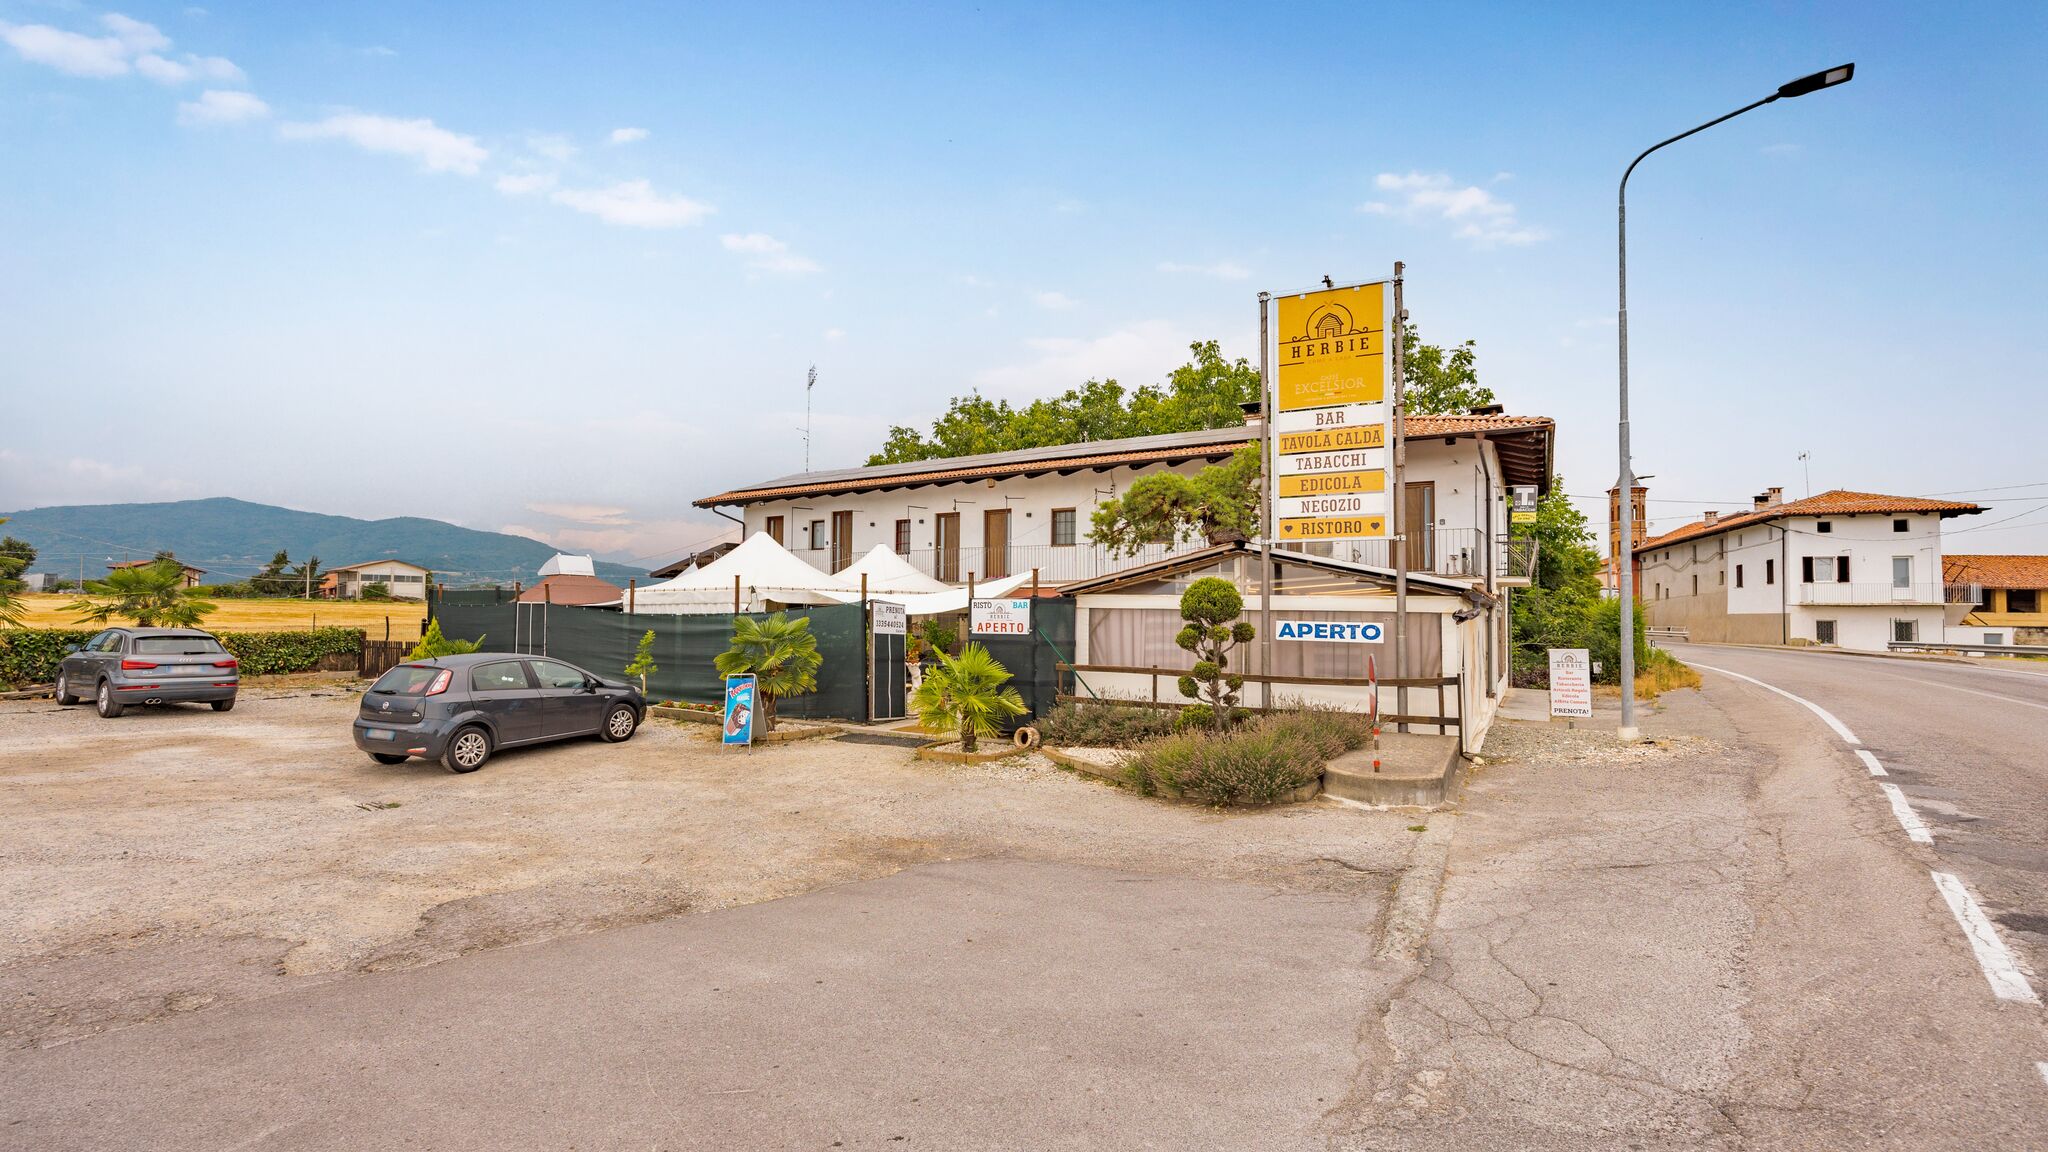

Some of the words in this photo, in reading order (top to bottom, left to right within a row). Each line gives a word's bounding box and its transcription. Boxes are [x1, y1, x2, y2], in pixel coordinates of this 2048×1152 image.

[1292, 338, 1369, 358] HERBIE
[1296, 377, 1366, 394] EXCELSIOR
[1316, 411, 1344, 425] BAR
[1282, 435, 1331, 450] TAVOLA
[1336, 430, 1382, 446] CALDA
[1296, 453, 1366, 470] TABACCHI
[1300, 476, 1362, 492] EDICOLA
[1516, 488, 1534, 505] T
[1301, 498, 1361, 513] NEGOZIO
[1301, 521, 1362, 535] RISTORO
[977, 623, 1024, 632] APERTO
[1279, 623, 1381, 640] APERTO
